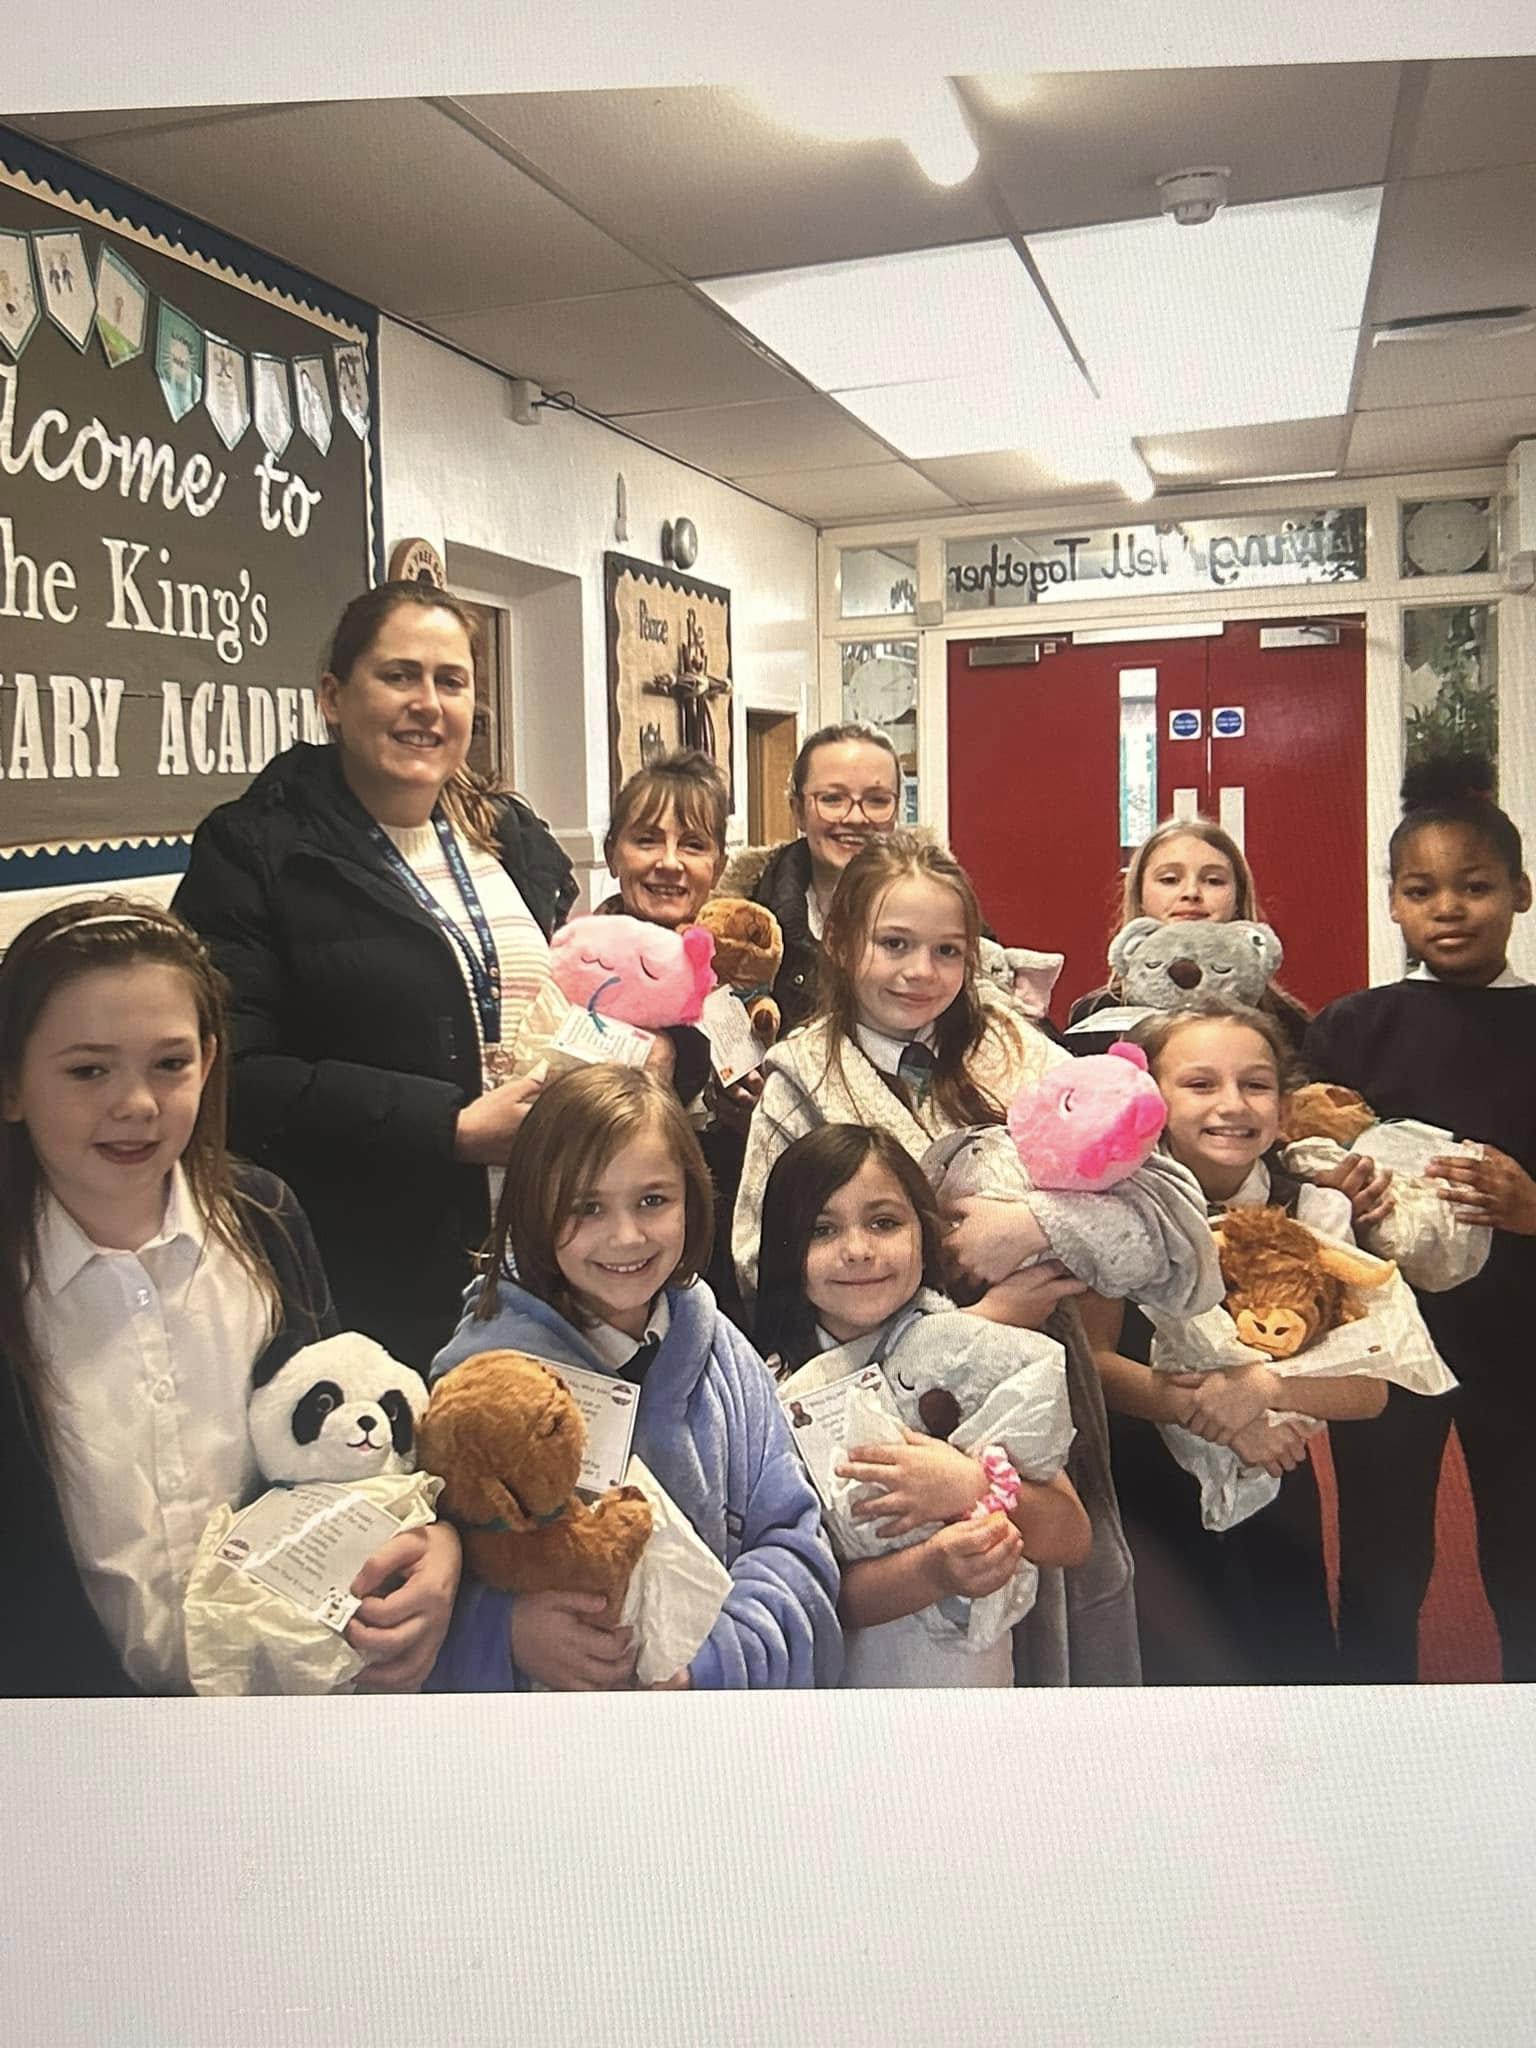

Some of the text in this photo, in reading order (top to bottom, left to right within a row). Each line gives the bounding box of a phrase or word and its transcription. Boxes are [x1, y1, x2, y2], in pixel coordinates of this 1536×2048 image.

[254, 451, 323, 538] to
[102, 537, 269, 664] King's
[0, 672, 126, 780] ARY
